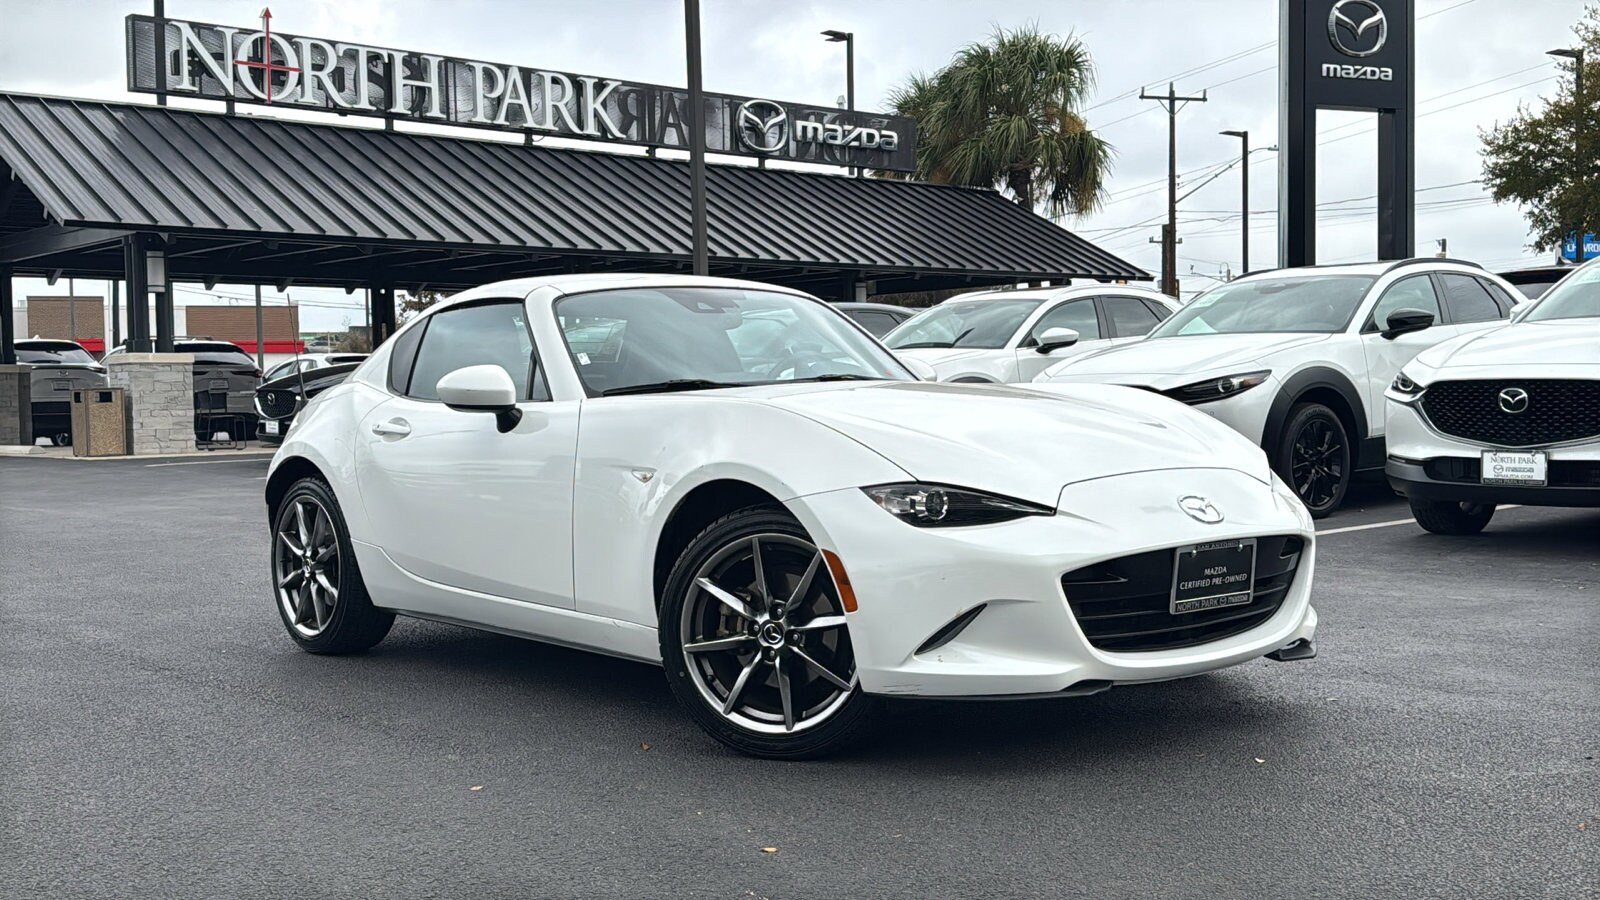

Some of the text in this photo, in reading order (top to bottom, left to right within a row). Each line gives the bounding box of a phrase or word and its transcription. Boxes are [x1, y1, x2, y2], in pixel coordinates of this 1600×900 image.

[168, 20, 627, 139] NORTH PARK
[1321, 63, 1393, 81] mazda
[795, 120, 899, 151] mazda
[1490, 456, 1537, 465] NORTH PARK
[1204, 566, 1227, 575] MAZDA
[1180, 573, 1247, 590] CERTIFIED PRE-OWNED
[1177, 602, 1200, 611] NORTH
[1201, 598, 1219, 607] PARK
